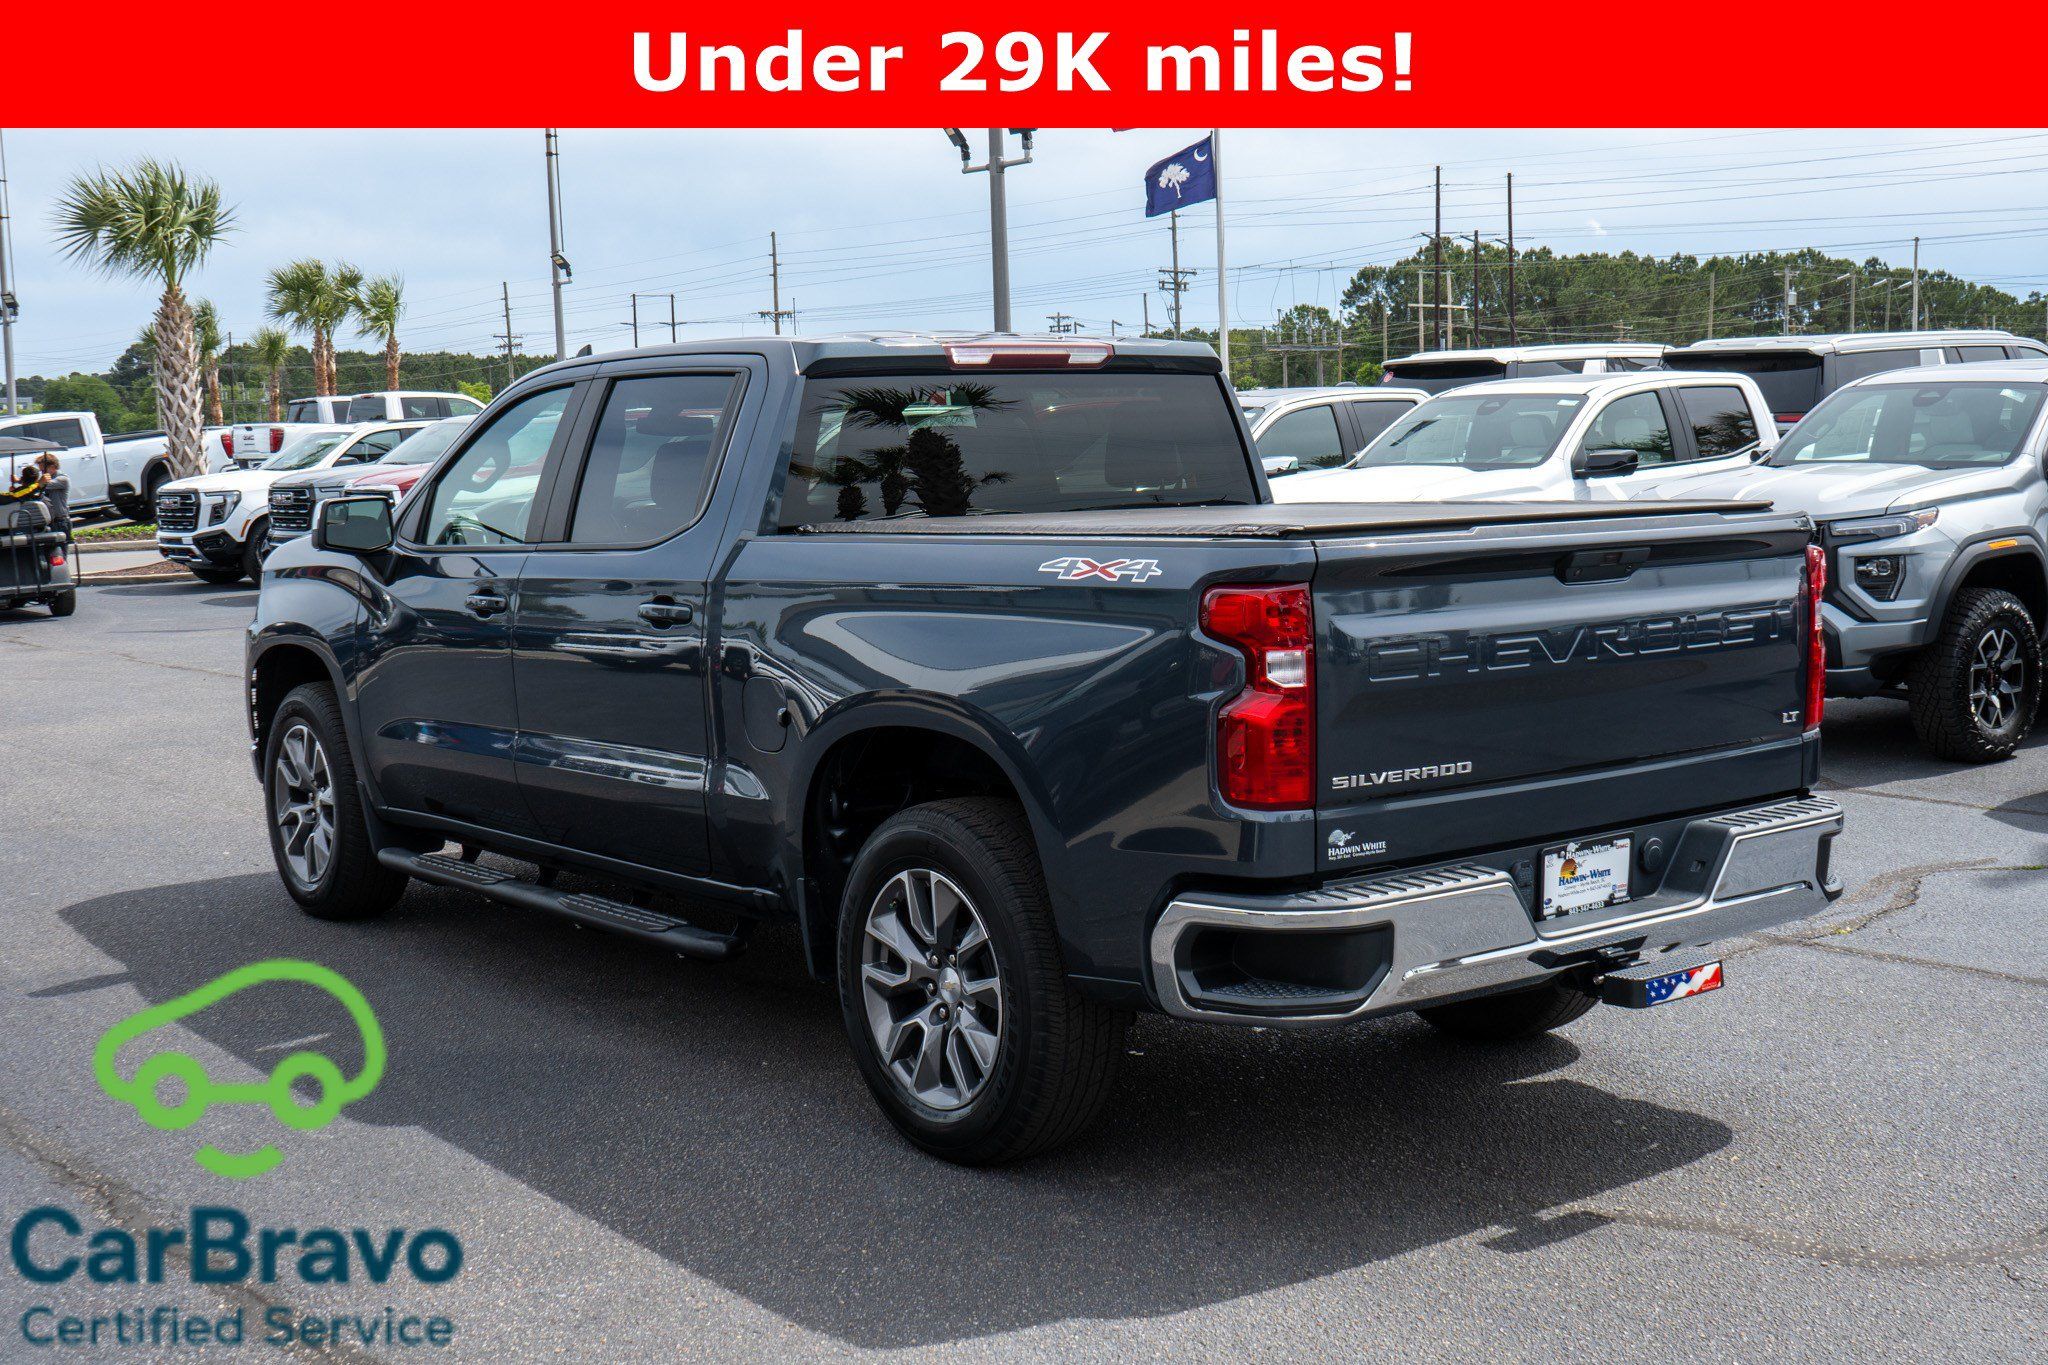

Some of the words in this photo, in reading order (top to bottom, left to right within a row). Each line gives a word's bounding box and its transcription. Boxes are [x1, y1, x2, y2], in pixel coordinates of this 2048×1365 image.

[1368, 603, 1796, 682] CHEVROLET
[1782, 711, 1800, 724] LT
[1331, 761, 1472, 789] SILVERADO
[1328, 845, 1361, 857] HADWIN
[1362, 841, 1387, 851] WHITE
